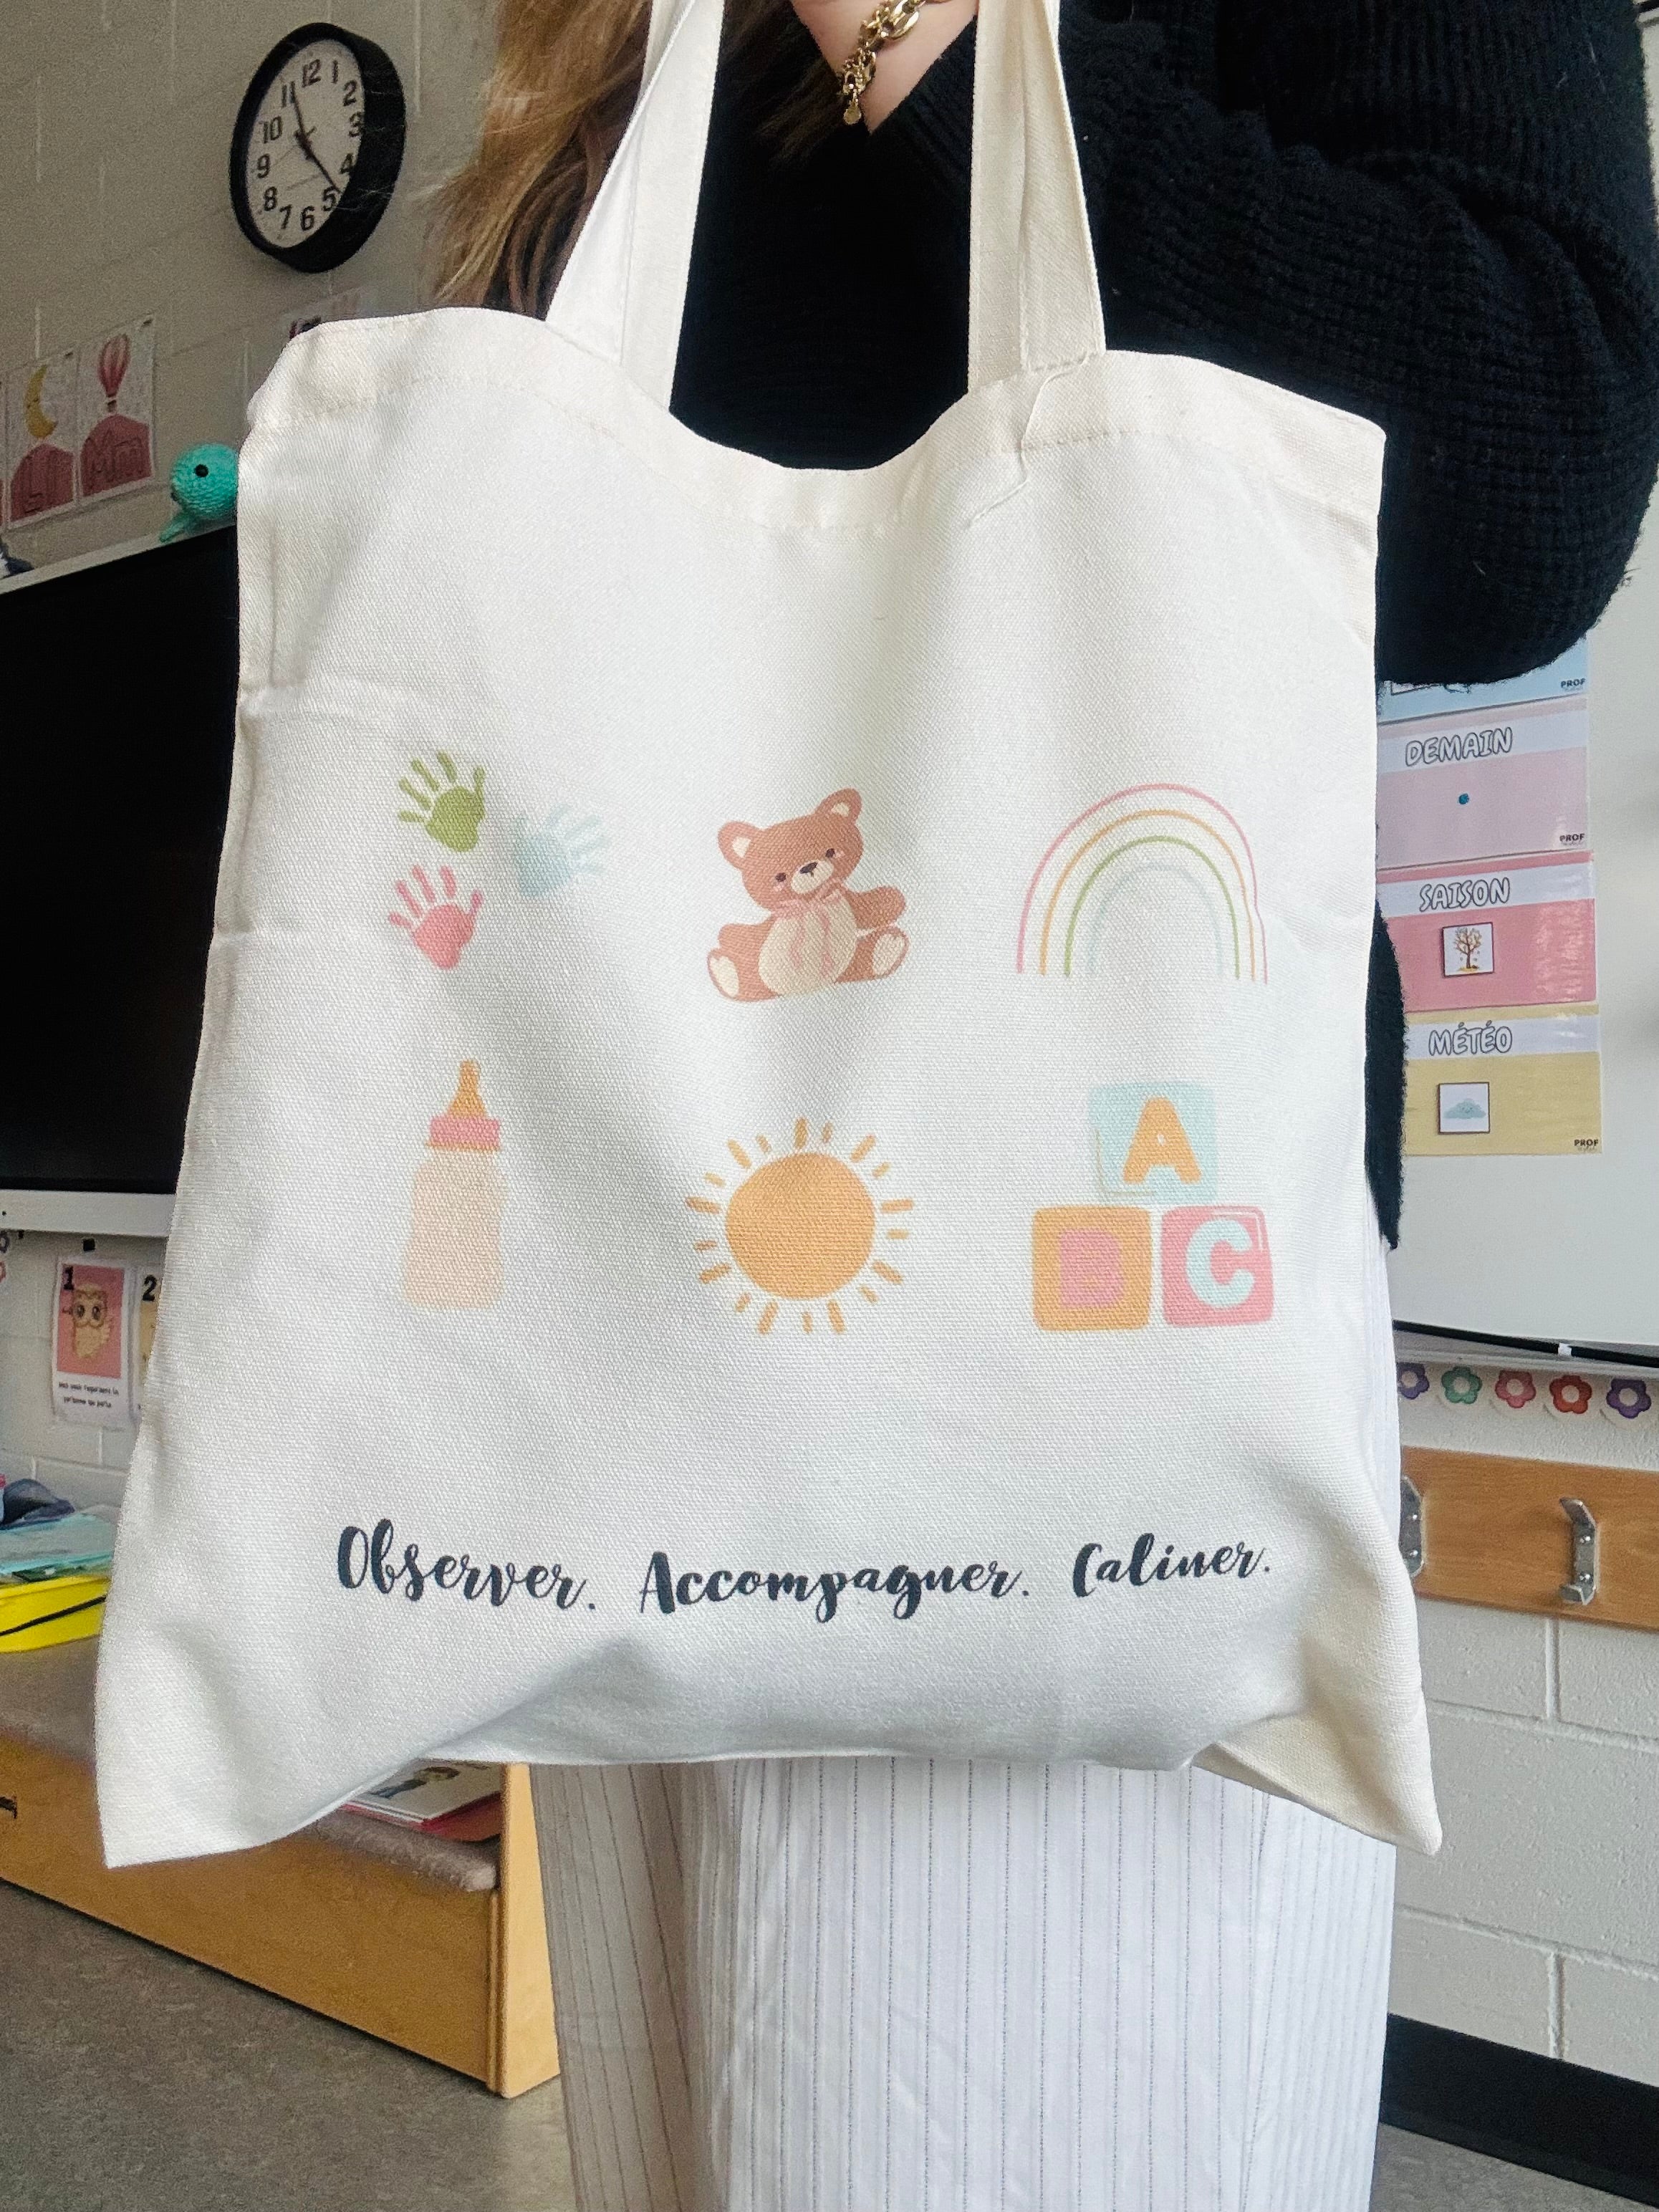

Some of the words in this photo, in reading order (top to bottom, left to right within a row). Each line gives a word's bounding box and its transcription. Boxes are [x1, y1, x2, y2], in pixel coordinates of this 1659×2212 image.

[301, 59, 322, 88] 12
[330, 59, 339, 84] 1
[282, 81, 296, 108] 11
[342, 80, 358, 107] 2
[261, 115, 283, 144] 10
[348, 111, 363, 138] 3
[256, 153, 271, 179] 9
[339, 153, 358, 175] 4
[263, 186, 278, 212] 8
[322, 186, 338, 212] 5
[279, 204, 293, 230] 7
[299, 206, 315, 231] 6
[1561, 678, 1586, 688] PROF
[1405, 726, 1514, 767] DEMAIN
[1559, 833, 1585, 842] PROF
[1418, 877, 1511, 913] SAISON
[1428, 1019, 1513, 1057] MÉTÉO
[1122, 1095, 1202, 1185] A
[1186, 1218, 1256, 1309] C
[64, 1266, 74, 1292] 1
[142, 1274, 158, 1302] 2
[337, 1518, 596, 1610] Observer.
[640, 1552, 1030, 1623] Accompagner.
[1072, 1532, 1271, 1598] Caliner.
